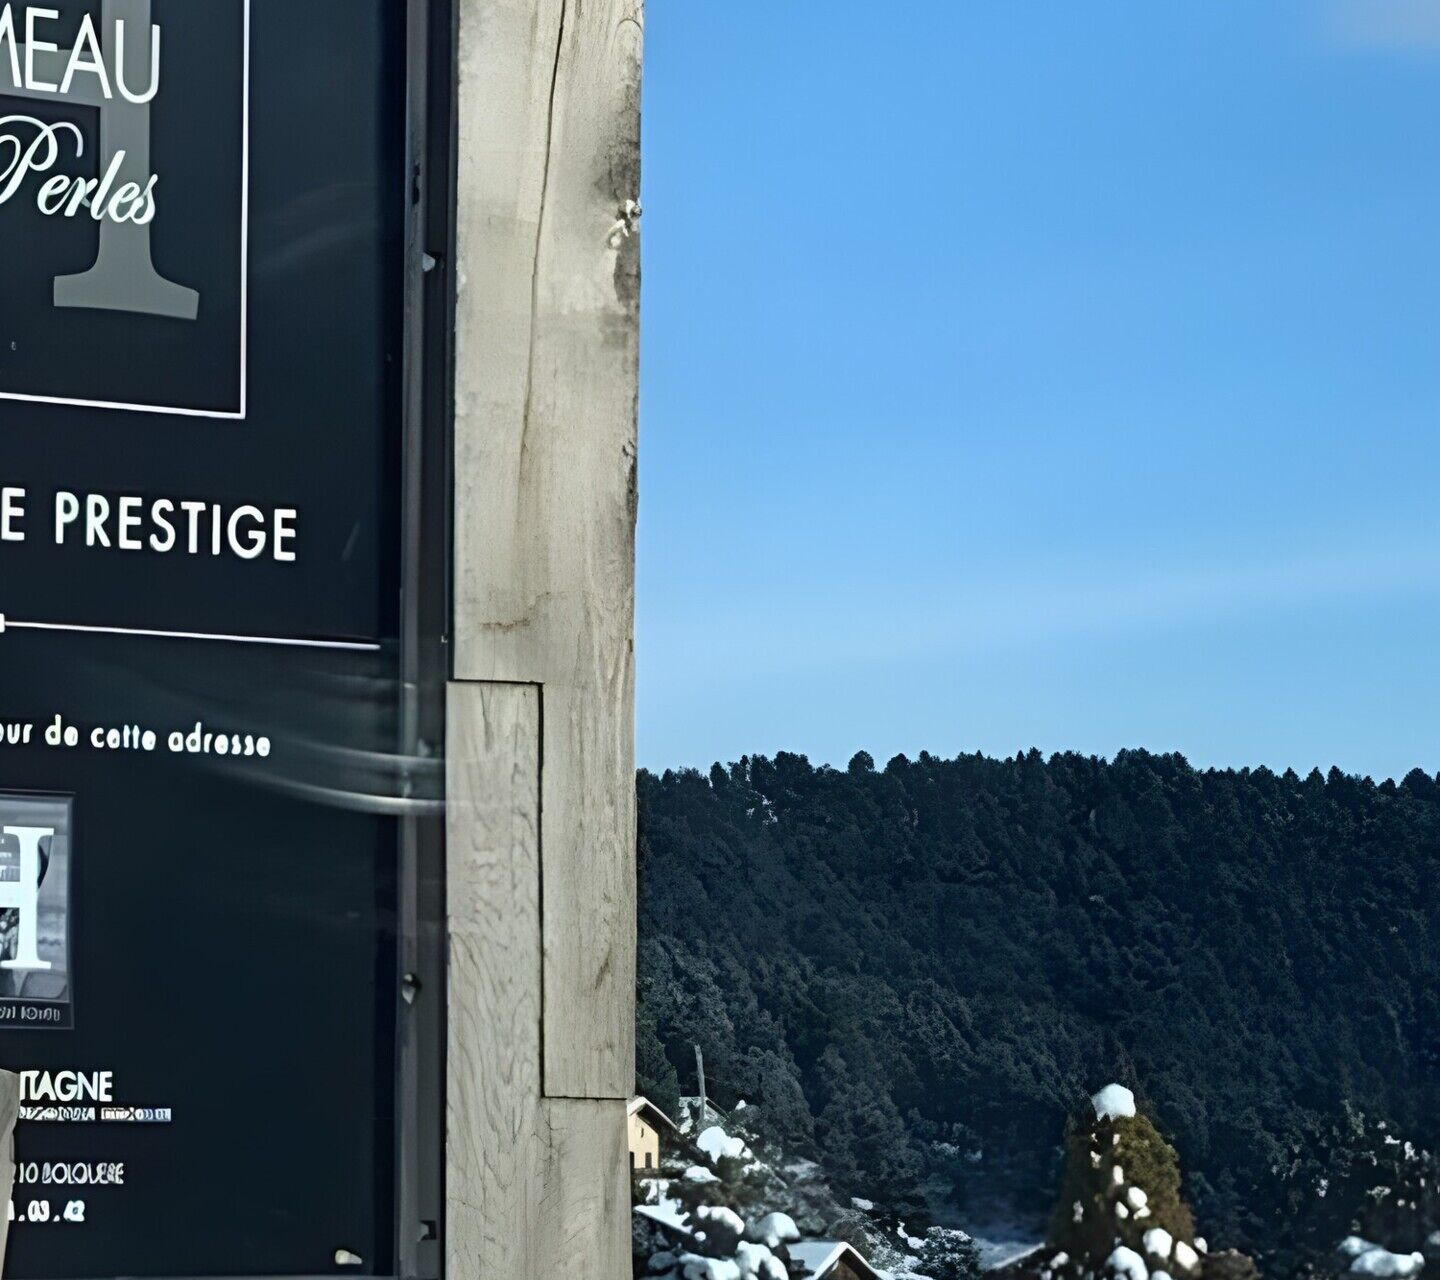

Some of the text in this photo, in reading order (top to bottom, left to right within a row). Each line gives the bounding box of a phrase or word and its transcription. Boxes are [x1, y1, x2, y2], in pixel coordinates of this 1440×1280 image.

[54, 490, 298, 562] PRESTIGE
[44, 713, 80, 747] de
[90, 724, 158, 752] cette
[167, 721, 271, 758] adresse
